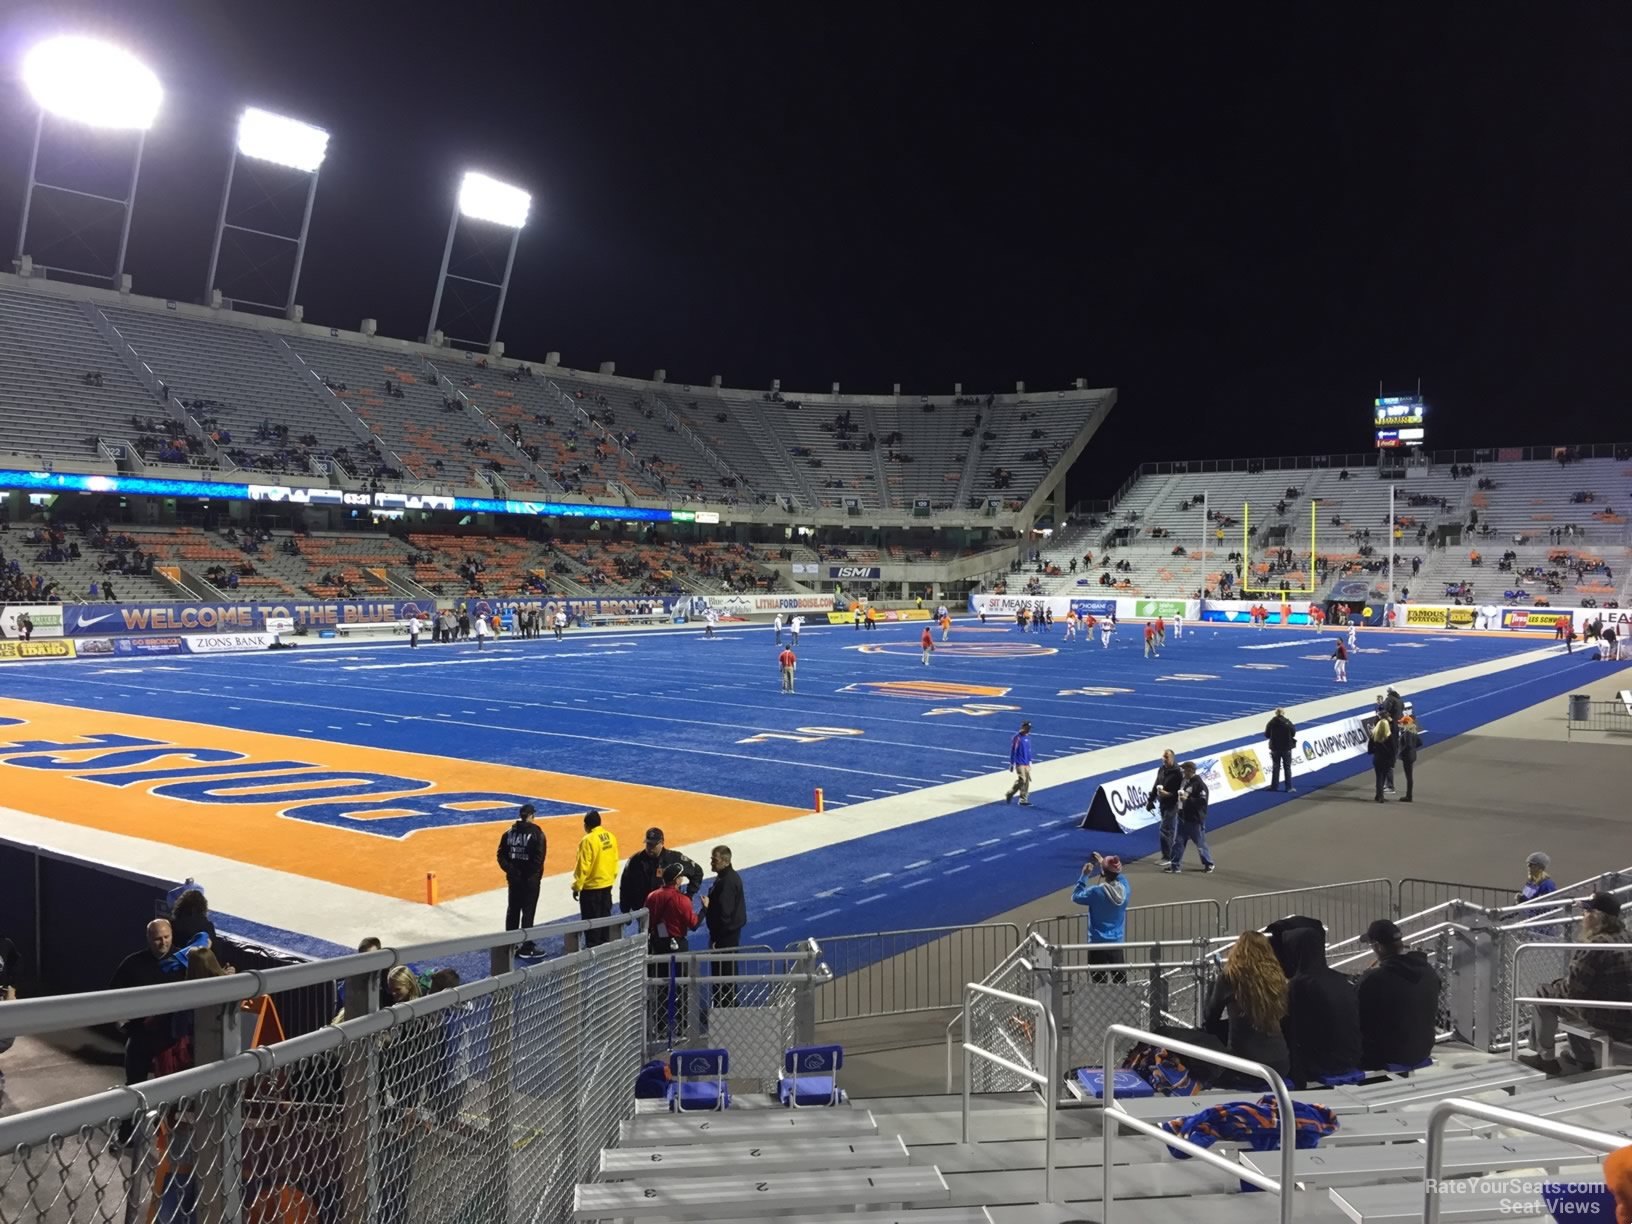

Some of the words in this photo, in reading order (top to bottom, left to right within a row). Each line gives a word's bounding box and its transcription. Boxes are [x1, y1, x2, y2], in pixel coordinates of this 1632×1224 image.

[838, 567, 871, 577] ISMI
[708, 597, 723, 605] Blue
[755, 597, 833, 609] LITHIAFORDBOISE.COM
[989, 599, 1000, 607] SIT
[1002, 599, 1032, 608] MEANS
[1034, 600, 1046, 609] SIT
[569, 600, 597, 615] THE
[121, 607, 253, 630] WELCOME
[295, 605, 338, 625] THE
[344, 603, 395, 623] BLUE
[1528, 615, 1539, 623] LES
[196, 637, 232, 648] ZIONS
[236, 636, 266, 647] BANK
[21, 646, 67, 655] IDAHO
[507, 832, 532, 846] MAV
[750, 1148, 761, 1157] 2
[756, 1182, 769, 1192] 2
